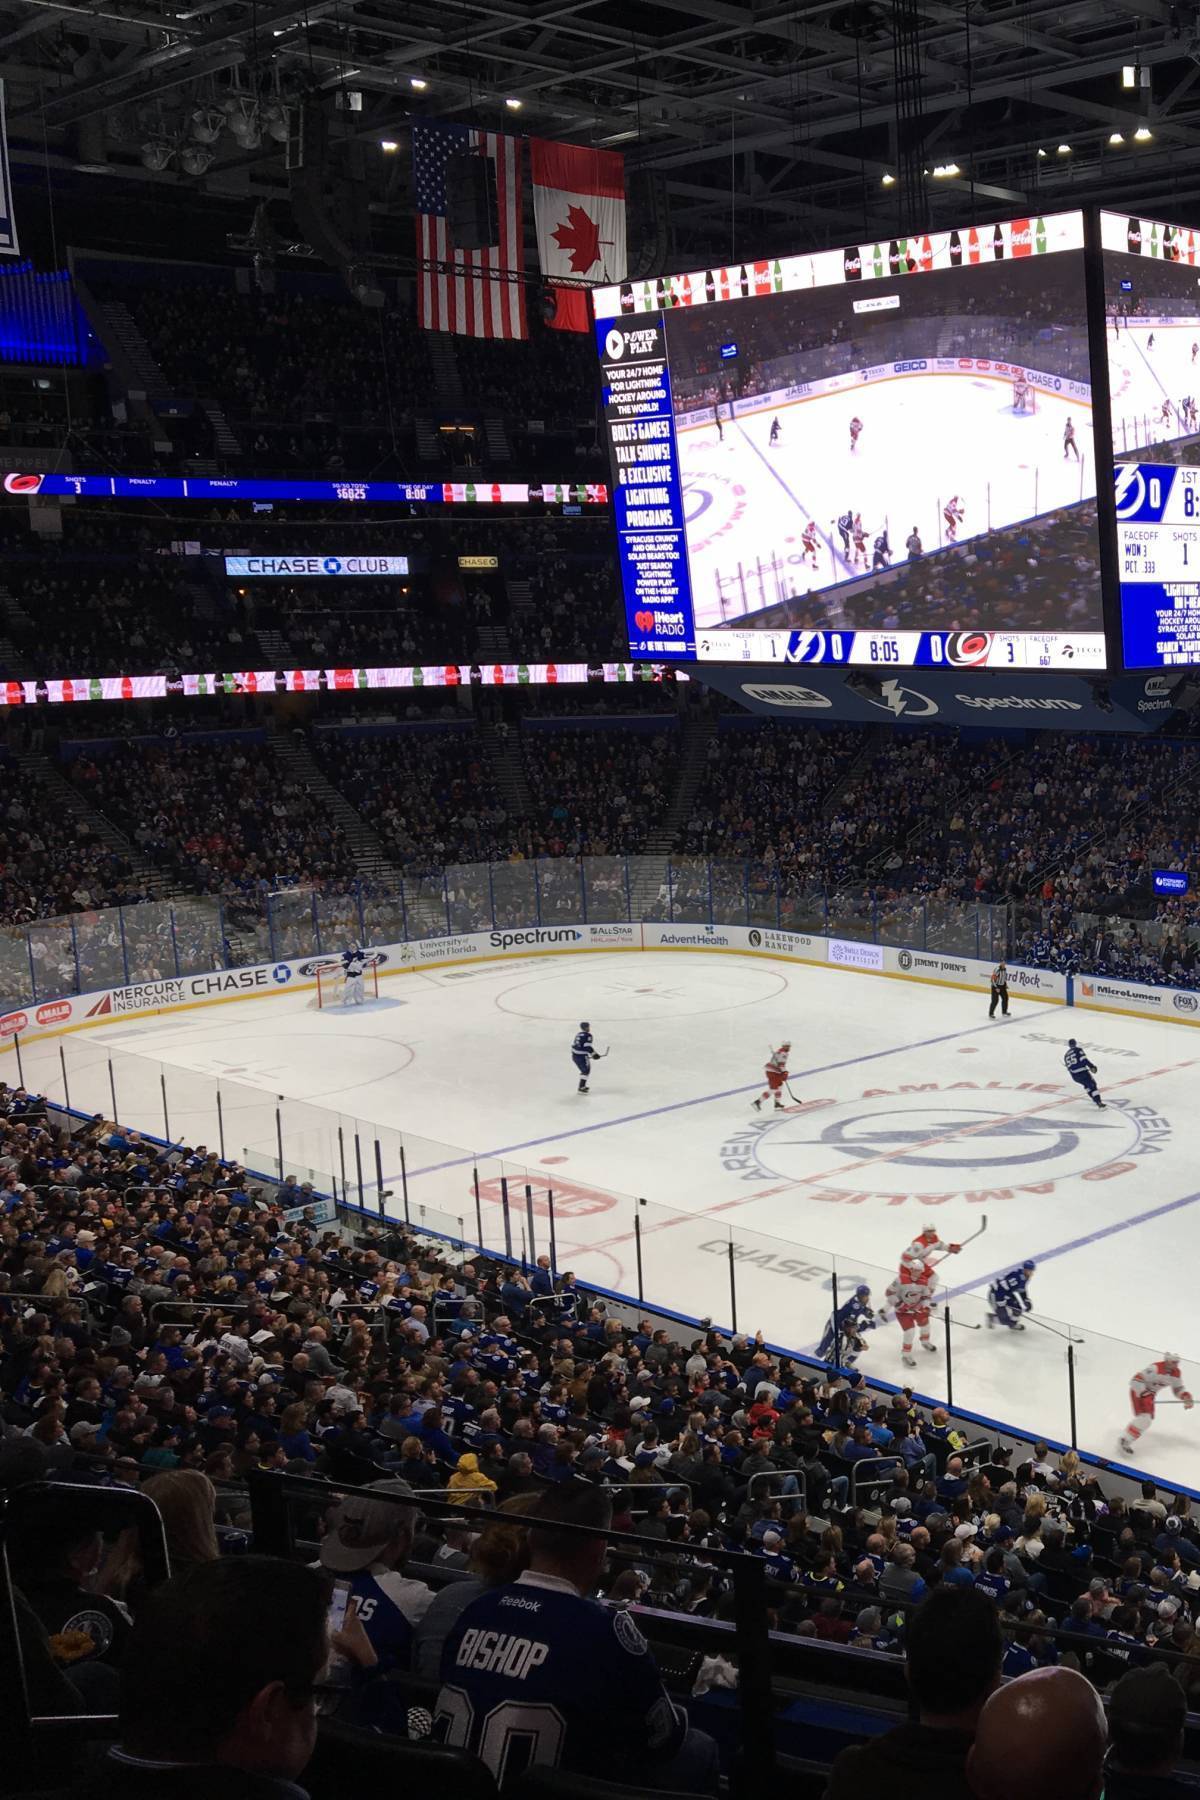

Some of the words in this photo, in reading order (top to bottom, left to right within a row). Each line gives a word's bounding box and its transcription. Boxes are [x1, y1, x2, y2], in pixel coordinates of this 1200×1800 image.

[623, 329, 658, 343] POWER
[630, 340, 653, 354] PLAY
[606, 370, 626, 380] YOUR
[626, 368, 641, 378] 24/7
[642, 365, 664, 376] HOME
[893, 360, 927, 373] GEICO
[610, 382, 625, 392] FOR
[625, 378, 661, 390] LIGHTNING
[1026, 371, 1054, 388] CHASE
[608, 392, 636, 404] HOCKEY
[636, 389, 666, 401] AROUND
[785, 384, 813, 397] JABIL
[617, 404, 631, 415] THE
[631, 402, 659, 413] WORLD!
[611, 423, 638, 441] BOLTS
[638, 420, 670, 440] GAMES!
[615, 446, 636, 463] TALK
[636, 443, 671, 462] SHOWS!
[619, 468, 627, 484] &
[627, 465, 672, 484] EXCLUSIVE
[1181, 472, 1197, 483] 1ST
[75, 483, 81, 493] 3
[1150, 478, 1161, 508] 0
[625, 487, 670, 506] LIGHTNING
[626, 509, 673, 527] PROGRAMS
[625, 535, 655, 544] SYRACUSE
[655, 534, 679, 543] CRUNCH
[1124, 531, 1159, 541] FACEOFF
[1172, 532, 1197, 541] SHOTS
[632, 544, 644, 552] AND
[645, 543, 673, 551] ORLANDO
[1125, 544, 1141, 556] WON
[1183, 543, 1188, 565] 1
[459, 558, 489, 567] CHASE
[628, 552, 646, 560] SOLAR
[647, 552, 665, 560] BEARS
[247, 559, 319, 573] CHASE
[347, 559, 389, 573] CLUB
[636, 562, 650, 570] JUST
[650, 562, 672, 570] SEARCH
[637, 579, 657, 587] POWER
[642, 596, 660, 604] RADIO
[1174, 597, 1184, 608] ON
[654, 610, 683, 624] iHeart
[655, 624, 685, 635] RADIO
[1158, 625, 1188, 633] SYRACUSE
[831, 633, 843, 660] 0
[870, 641, 899, 662] 8:05
[930, 635, 942, 662] 0
[1007, 643, 1014, 663] 3
[1173, 652, 1187, 664] YOUR
[752, 689, 824, 702] AMALIE
[955, 694, 1082, 711] Spectrum
[419, 939, 462, 950] University
[489, 928, 576, 950] Spectrum
[660, 933, 729, 945] AdventHealth
[764, 932, 812, 946] LAKEWOOD
[420, 949, 445, 959] South
[446, 945, 477, 956] Florida
[764, 941, 793, 952] RANCH
[914, 958, 939, 968] JIMMY
[940, 962, 966, 972] JOHN'S
[191, 969, 268, 995] CHASE
[1019, 971, 1040, 988] Rock
[113, 980, 183, 1001] MERCURY
[1097, 986, 1161, 1002] MicroLumen
[114, 991, 186, 1012] INSURANCE
[1178, 996, 1193, 1006] FOX
[38, 1005, 70, 1020] AMALIE
[1066, 1053, 1077, 1067] 55
[862, 1080, 1067, 1099] AMALIE
[1108, 1097, 1173, 1157] ARENA
[719, 1118, 784, 1181] ARENA
[808, 1181, 1056, 1206] AMALIE
[698, 1239, 826, 1284] CHASE
[499, 1594, 541, 1613] Reebok
[455, 1628, 549, 1681] BISHOP
